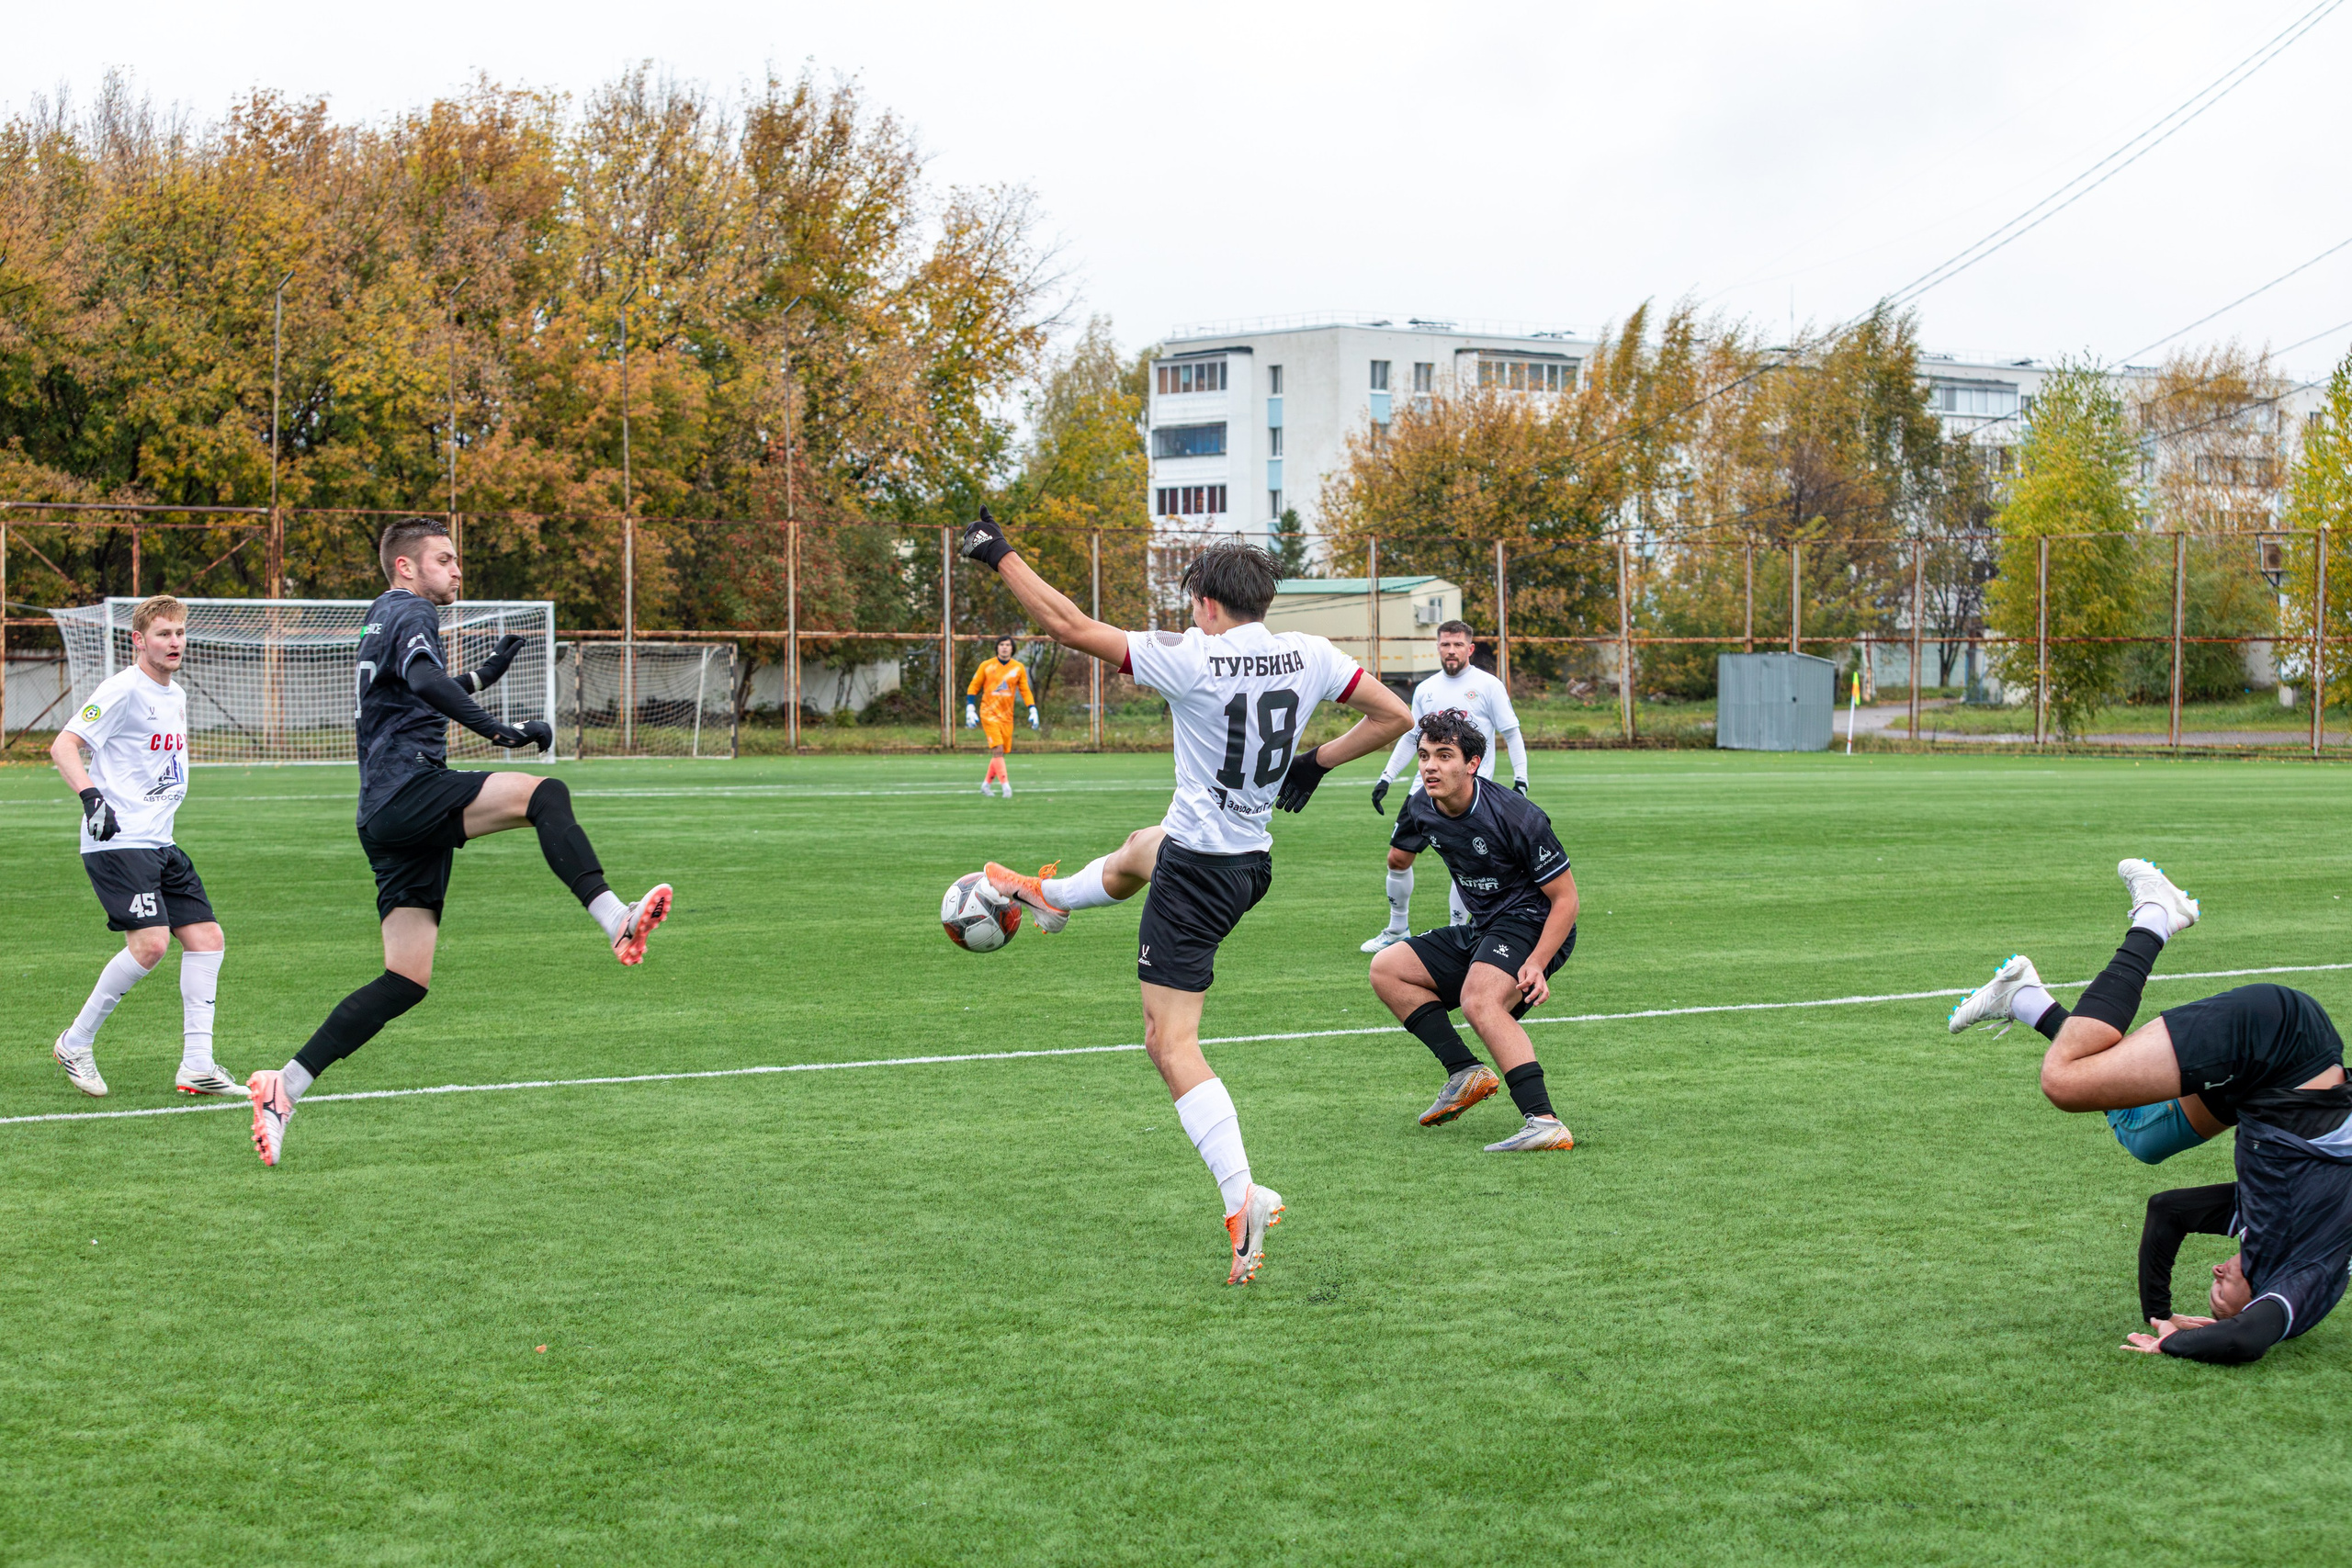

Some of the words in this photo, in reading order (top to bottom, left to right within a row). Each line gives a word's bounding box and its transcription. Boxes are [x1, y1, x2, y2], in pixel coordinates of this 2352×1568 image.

[1209, 650, 1304, 677] ТУРБИНА
[1216, 689, 1299, 790] 18
[129, 892, 158, 919] 45
